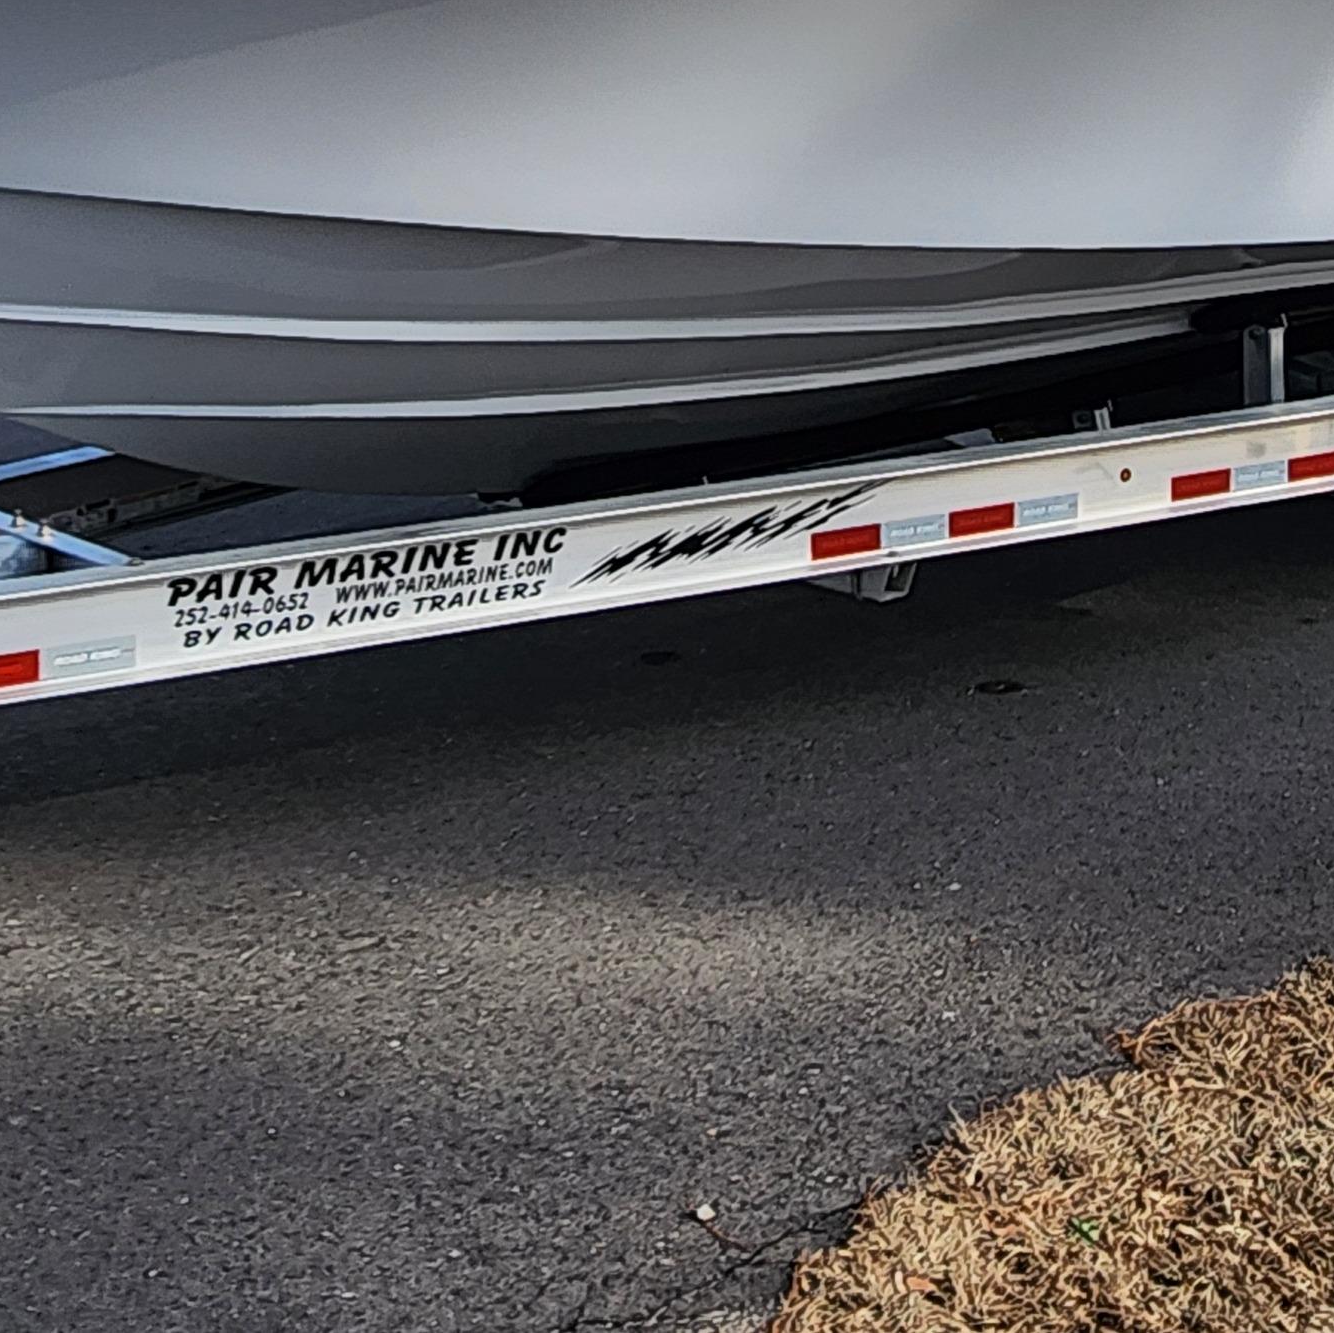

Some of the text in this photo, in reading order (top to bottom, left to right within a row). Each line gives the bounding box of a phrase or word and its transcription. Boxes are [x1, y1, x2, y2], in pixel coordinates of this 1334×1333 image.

[167, 527, 567, 607] PAIR MARINE INC
[174, 557, 554, 627] 252-414-0652 WWW.PAIRMARINE.COM
[183, 580, 547, 648] BY ROAD KING TRAILERS
